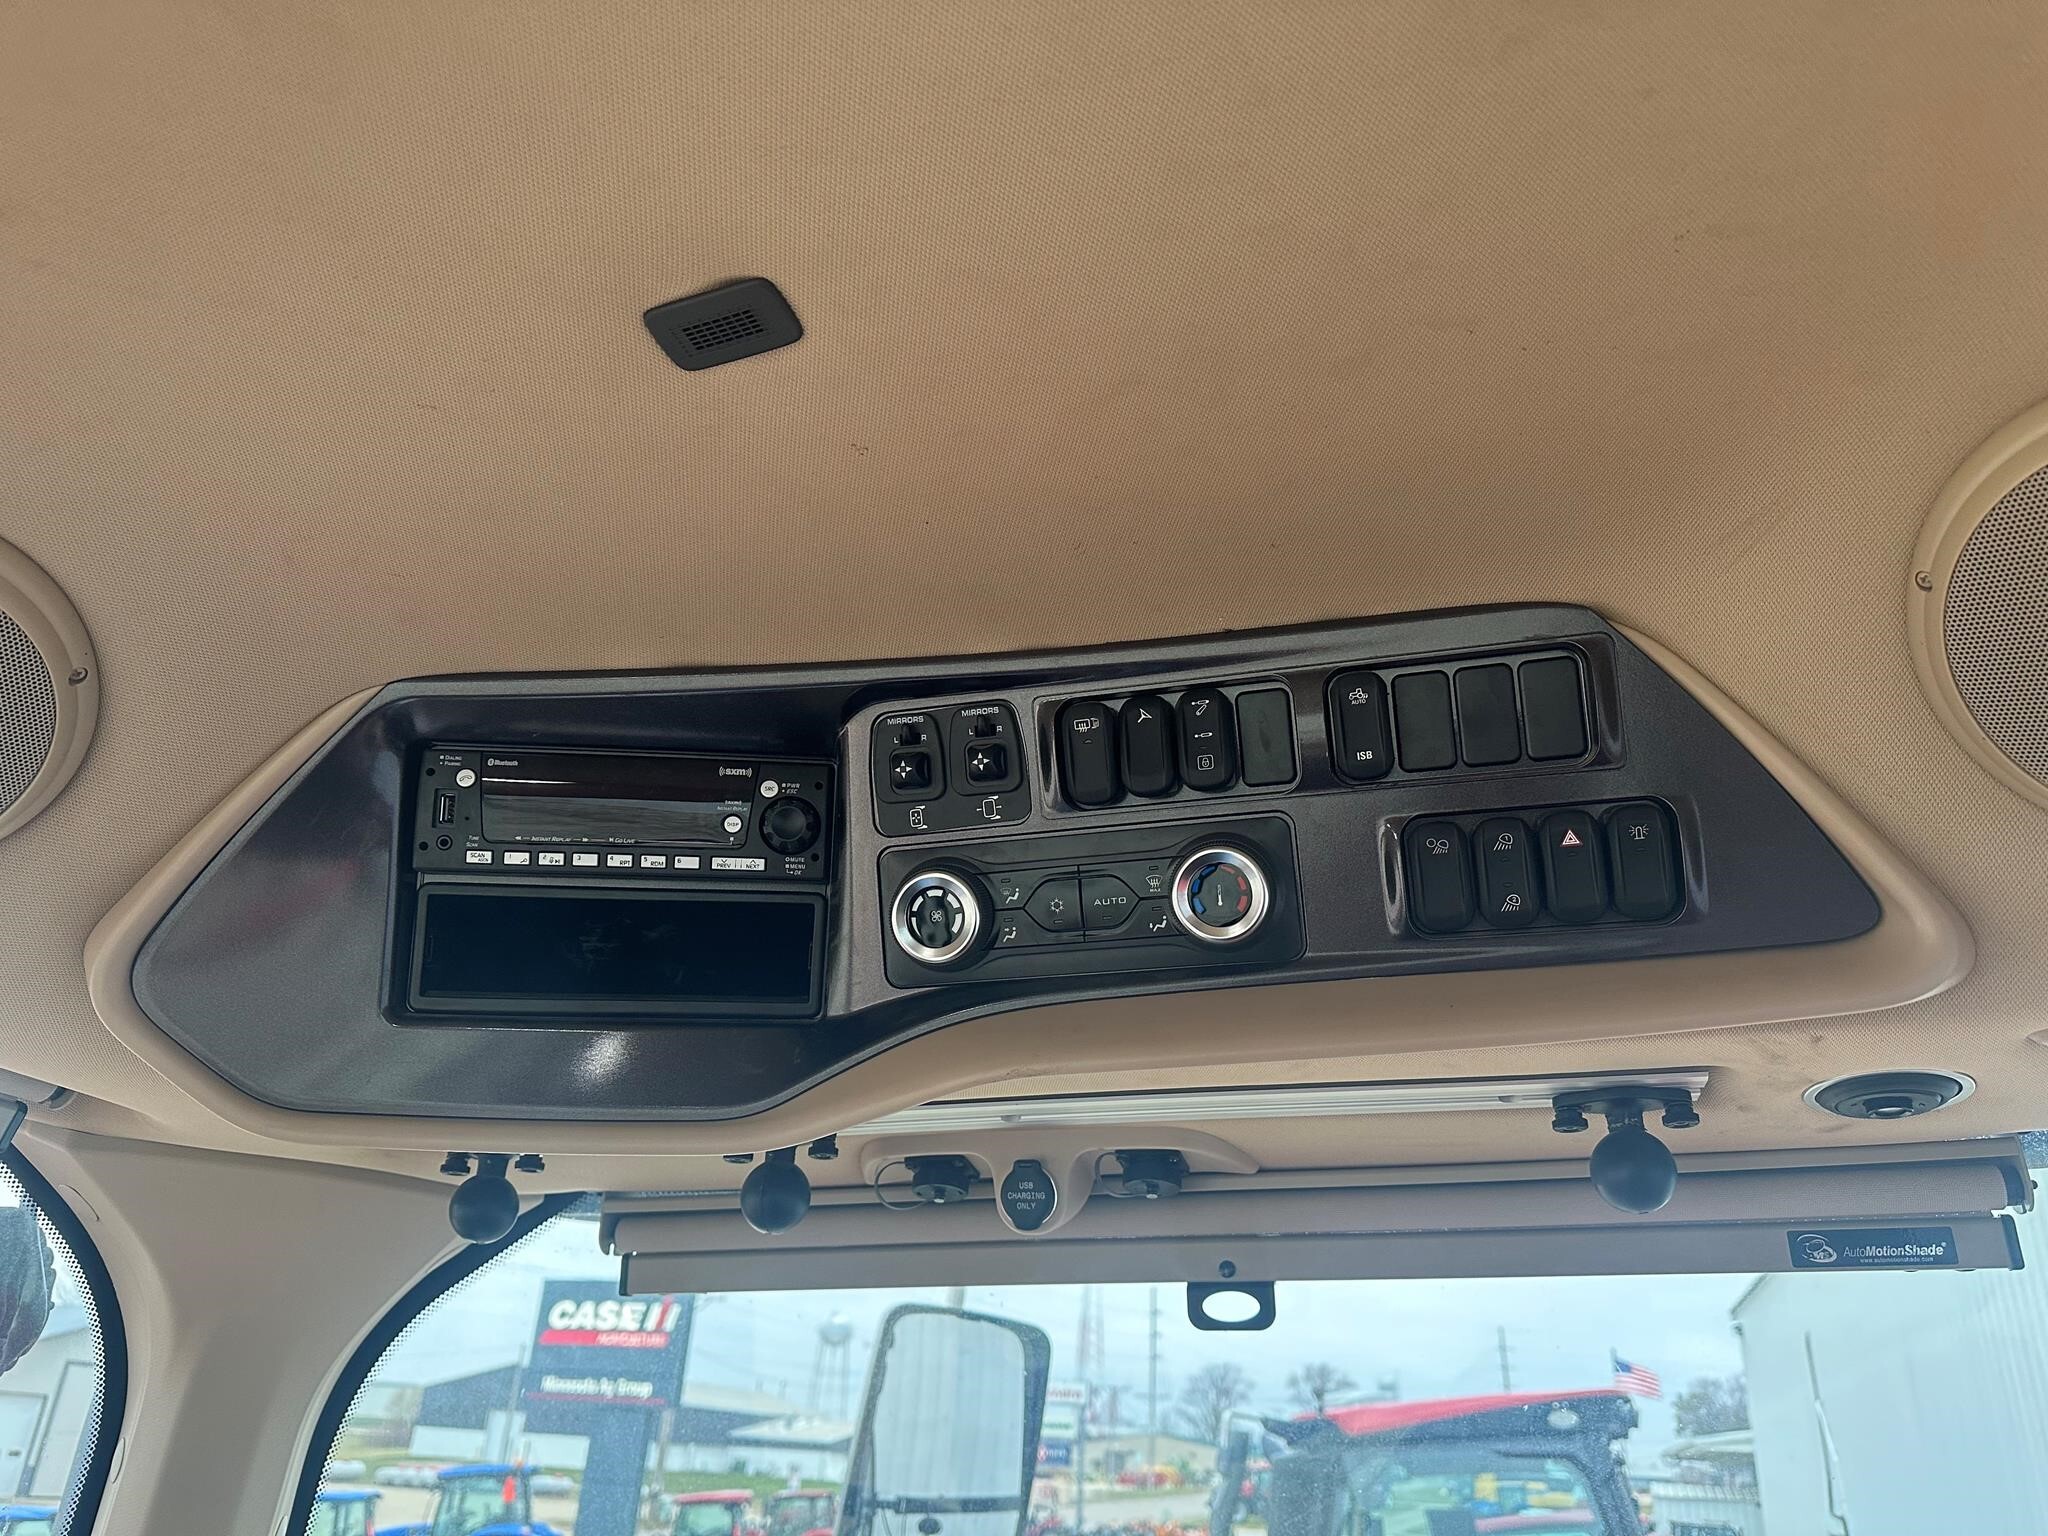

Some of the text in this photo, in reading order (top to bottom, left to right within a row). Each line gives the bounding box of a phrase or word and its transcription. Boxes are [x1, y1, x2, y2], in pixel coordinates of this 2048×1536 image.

[961, 706, 999, 717] MIRRORS
[887, 715, 924, 725] MIRRORS
[996, 725, 1003, 733] R
[893, 736, 899, 744] L
[1356, 750, 1373, 761] ISB
[1093, 896, 1127, 906] AUTO
[1018, 1181, 1034, 1190] USB
[1007, 1191, 1046, 1200] CHARGING
[1016, 1201, 1036, 1210] ONLY
[548, 1299, 647, 1331] CASE
